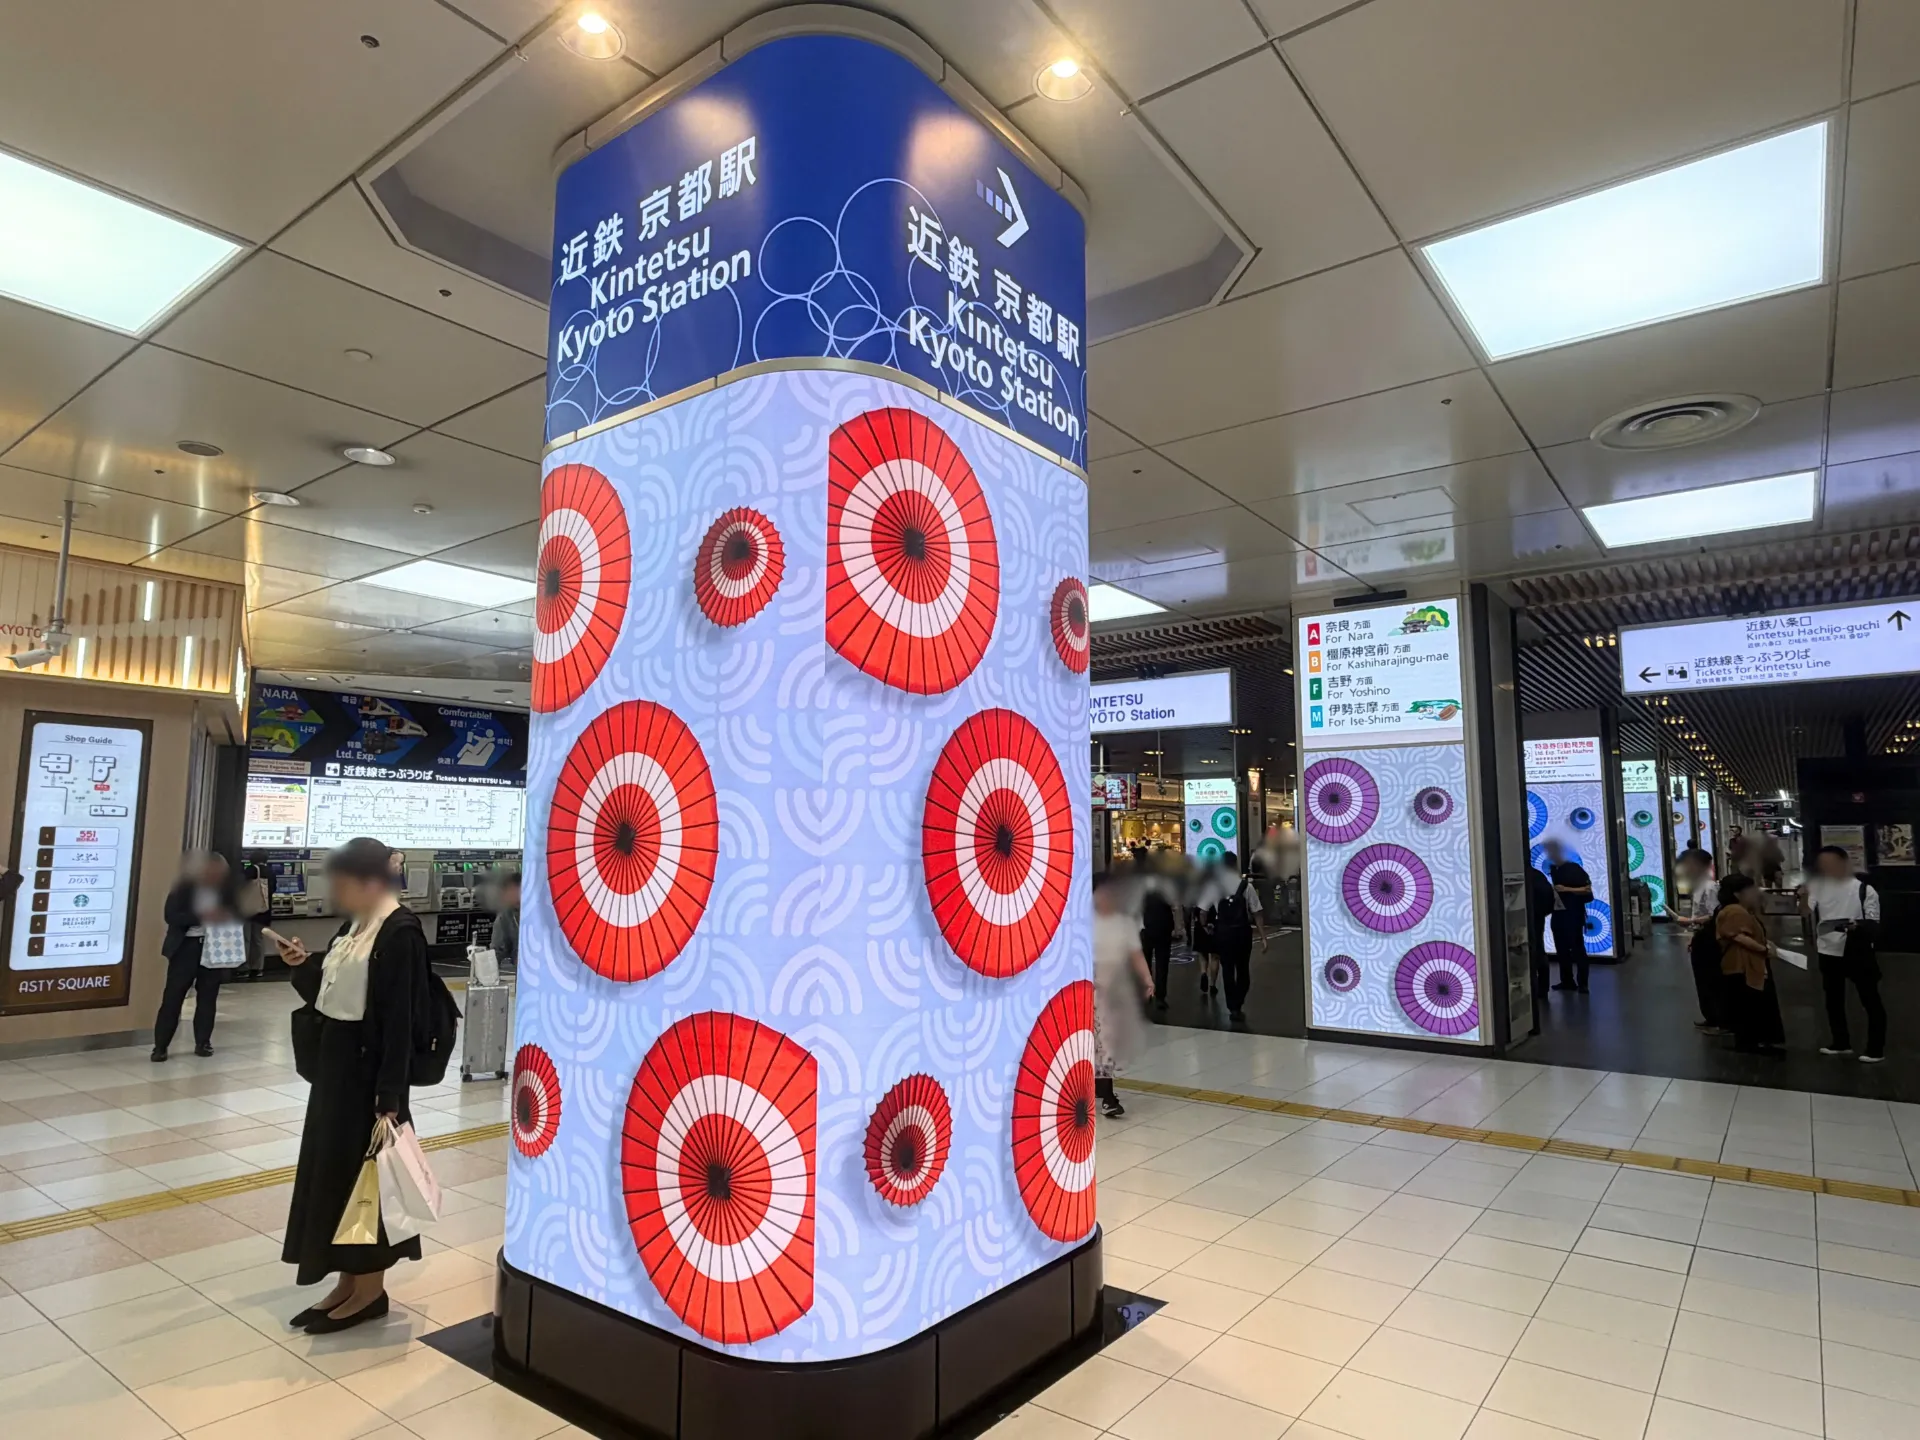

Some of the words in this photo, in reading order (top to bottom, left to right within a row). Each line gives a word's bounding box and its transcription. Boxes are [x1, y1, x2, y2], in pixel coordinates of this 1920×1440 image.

[560, 213, 624, 286] 近鉄
[638, 136, 757, 241] 京都駅
[590, 226, 711, 309] Kintetsu
[907, 205, 980, 298] 近鉄
[993, 268, 1080, 368] 京都駅
[557, 305, 634, 364] Kyoto
[642, 249, 751, 323] Station
[948, 290, 1053, 389] Kintetsu
[909, 309, 993, 388] Kyoto
[1000, 365, 1080, 441] Station
[1326, 620, 1350, 633] 奈良
[1354, 620, 1371, 630] 方面
[1746, 616, 1812, 632] 近鉄八条口
[1746, 629, 1794, 641] Kintetsu
[1797, 620, 1880, 636] Hachijo-guchi
[1326, 635, 1341, 644] For
[1348, 631, 1374, 642] Nara
[1327, 643, 1389, 660] 橿原神宮前
[1394, 644, 1411, 653] 方面
[1694, 648, 1811, 668] 近鉄線きっぷうりば
[1327, 662, 1342, 671] For
[1347, 651, 1449, 669] Kashiharajingu-mae
[1695, 666, 1732, 677] Tickets
[1735, 665, 1752, 674] for
[1755, 662, 1803, 672] Kintetsu
[1806, 659, 1831, 668] Line
[1327, 675, 1352, 688] 吉野
[1356, 676, 1373, 686] 方面
[262, 688, 299, 701] NARA
[1327, 690, 1343, 699] For
[1350, 686, 1391, 697] Yoshino
[1090, 693, 1143, 708] INTETSU
[438, 706, 492, 720] Comfortable!
[1090, 709, 1125, 723] YŌTO
[1130, 707, 1175, 721] Station
[1328, 701, 1379, 716] 伊勢志摩
[1382, 703, 1399, 712] 方面
[1328, 718, 1345, 727] For
[1351, 715, 1401, 726] Ise-Shima
[300, 725, 316, 734] 나라
[64, 734, 86, 743] Shop
[88, 736, 113, 744] Guide
[336, 750, 354, 759] Ltd.
[356, 751, 376, 762] Exp.
[343, 765, 434, 780] 近鉄線きっぷうりば
[435, 775, 458, 783] Tickets
[468, 777, 499, 785] KINTETSU
[80, 830, 96, 838] 551
[68, 876, 98, 885] DONQ
[19, 979, 54, 993] ASTY
[57, 975, 111, 991] SQUARE
